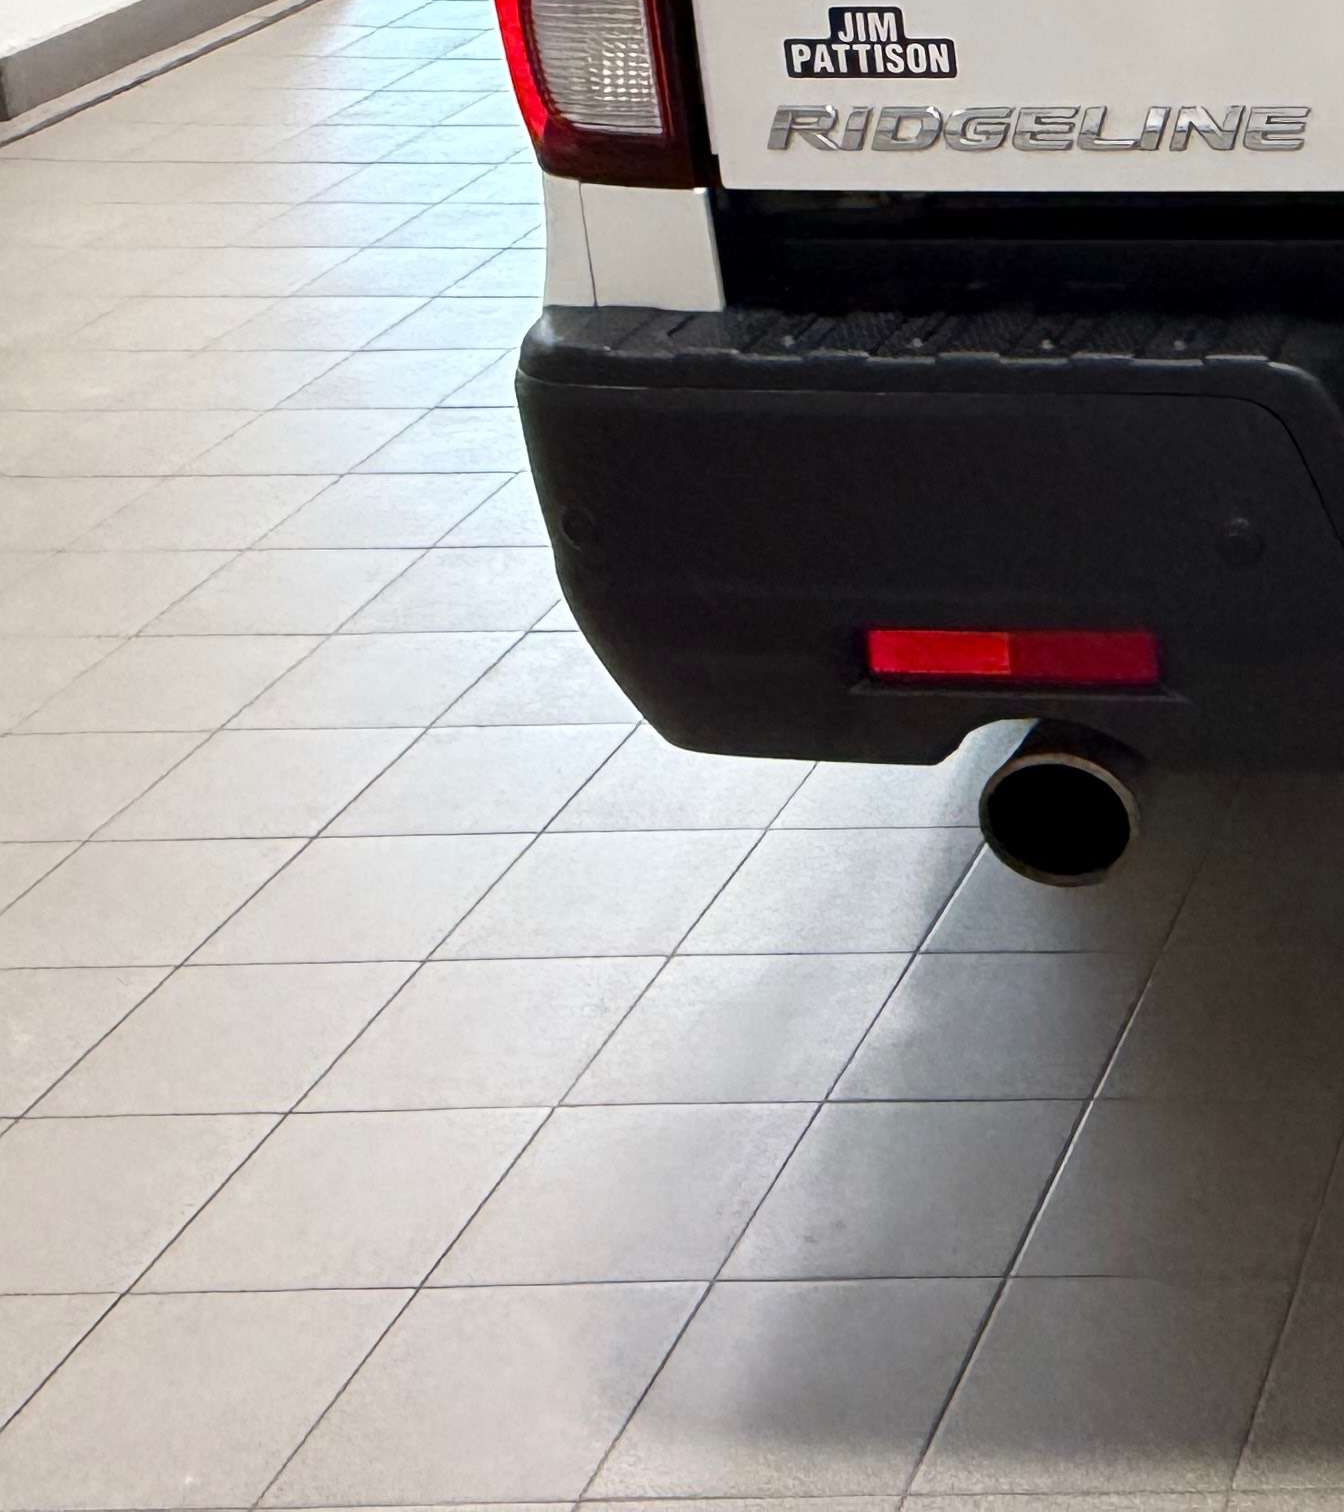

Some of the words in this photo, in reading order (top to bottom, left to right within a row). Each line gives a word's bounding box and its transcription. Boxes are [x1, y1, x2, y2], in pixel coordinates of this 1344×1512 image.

[837, 11, 898, 43] JIM
[791, 43, 950, 74] PATTISON
[766, 104, 1312, 152] RIDGELINE
